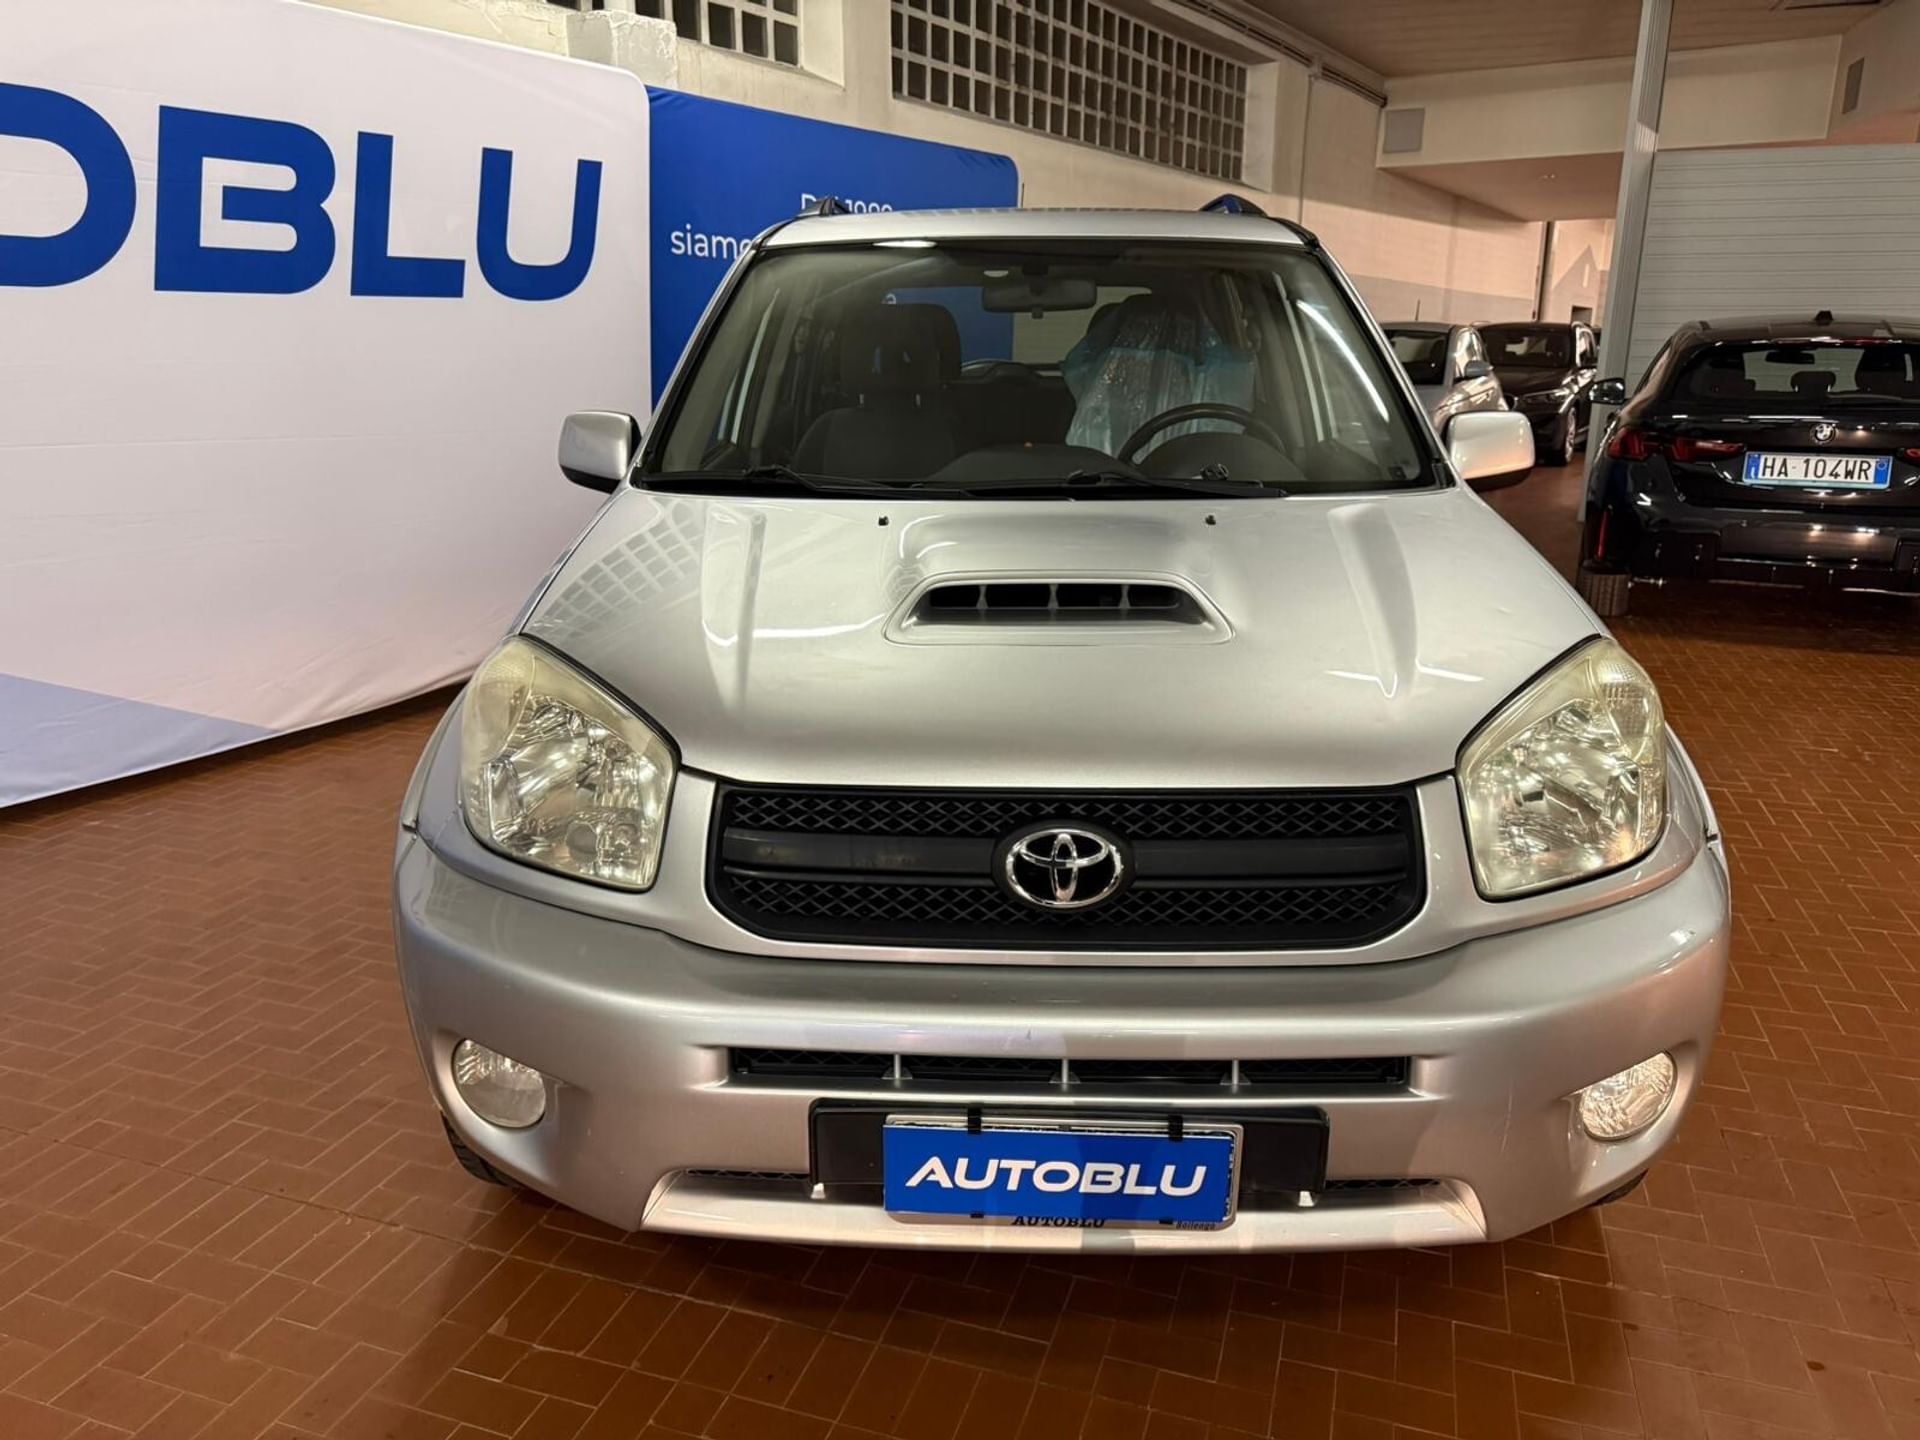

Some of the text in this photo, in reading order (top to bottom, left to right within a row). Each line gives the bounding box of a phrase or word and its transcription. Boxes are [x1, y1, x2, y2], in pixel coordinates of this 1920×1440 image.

[1761, 456, 1872, 481] HA 104WR
[905, 1155, 1207, 1197] AUTOBLU
[1010, 1215, 1106, 1229] AUTOBLU
